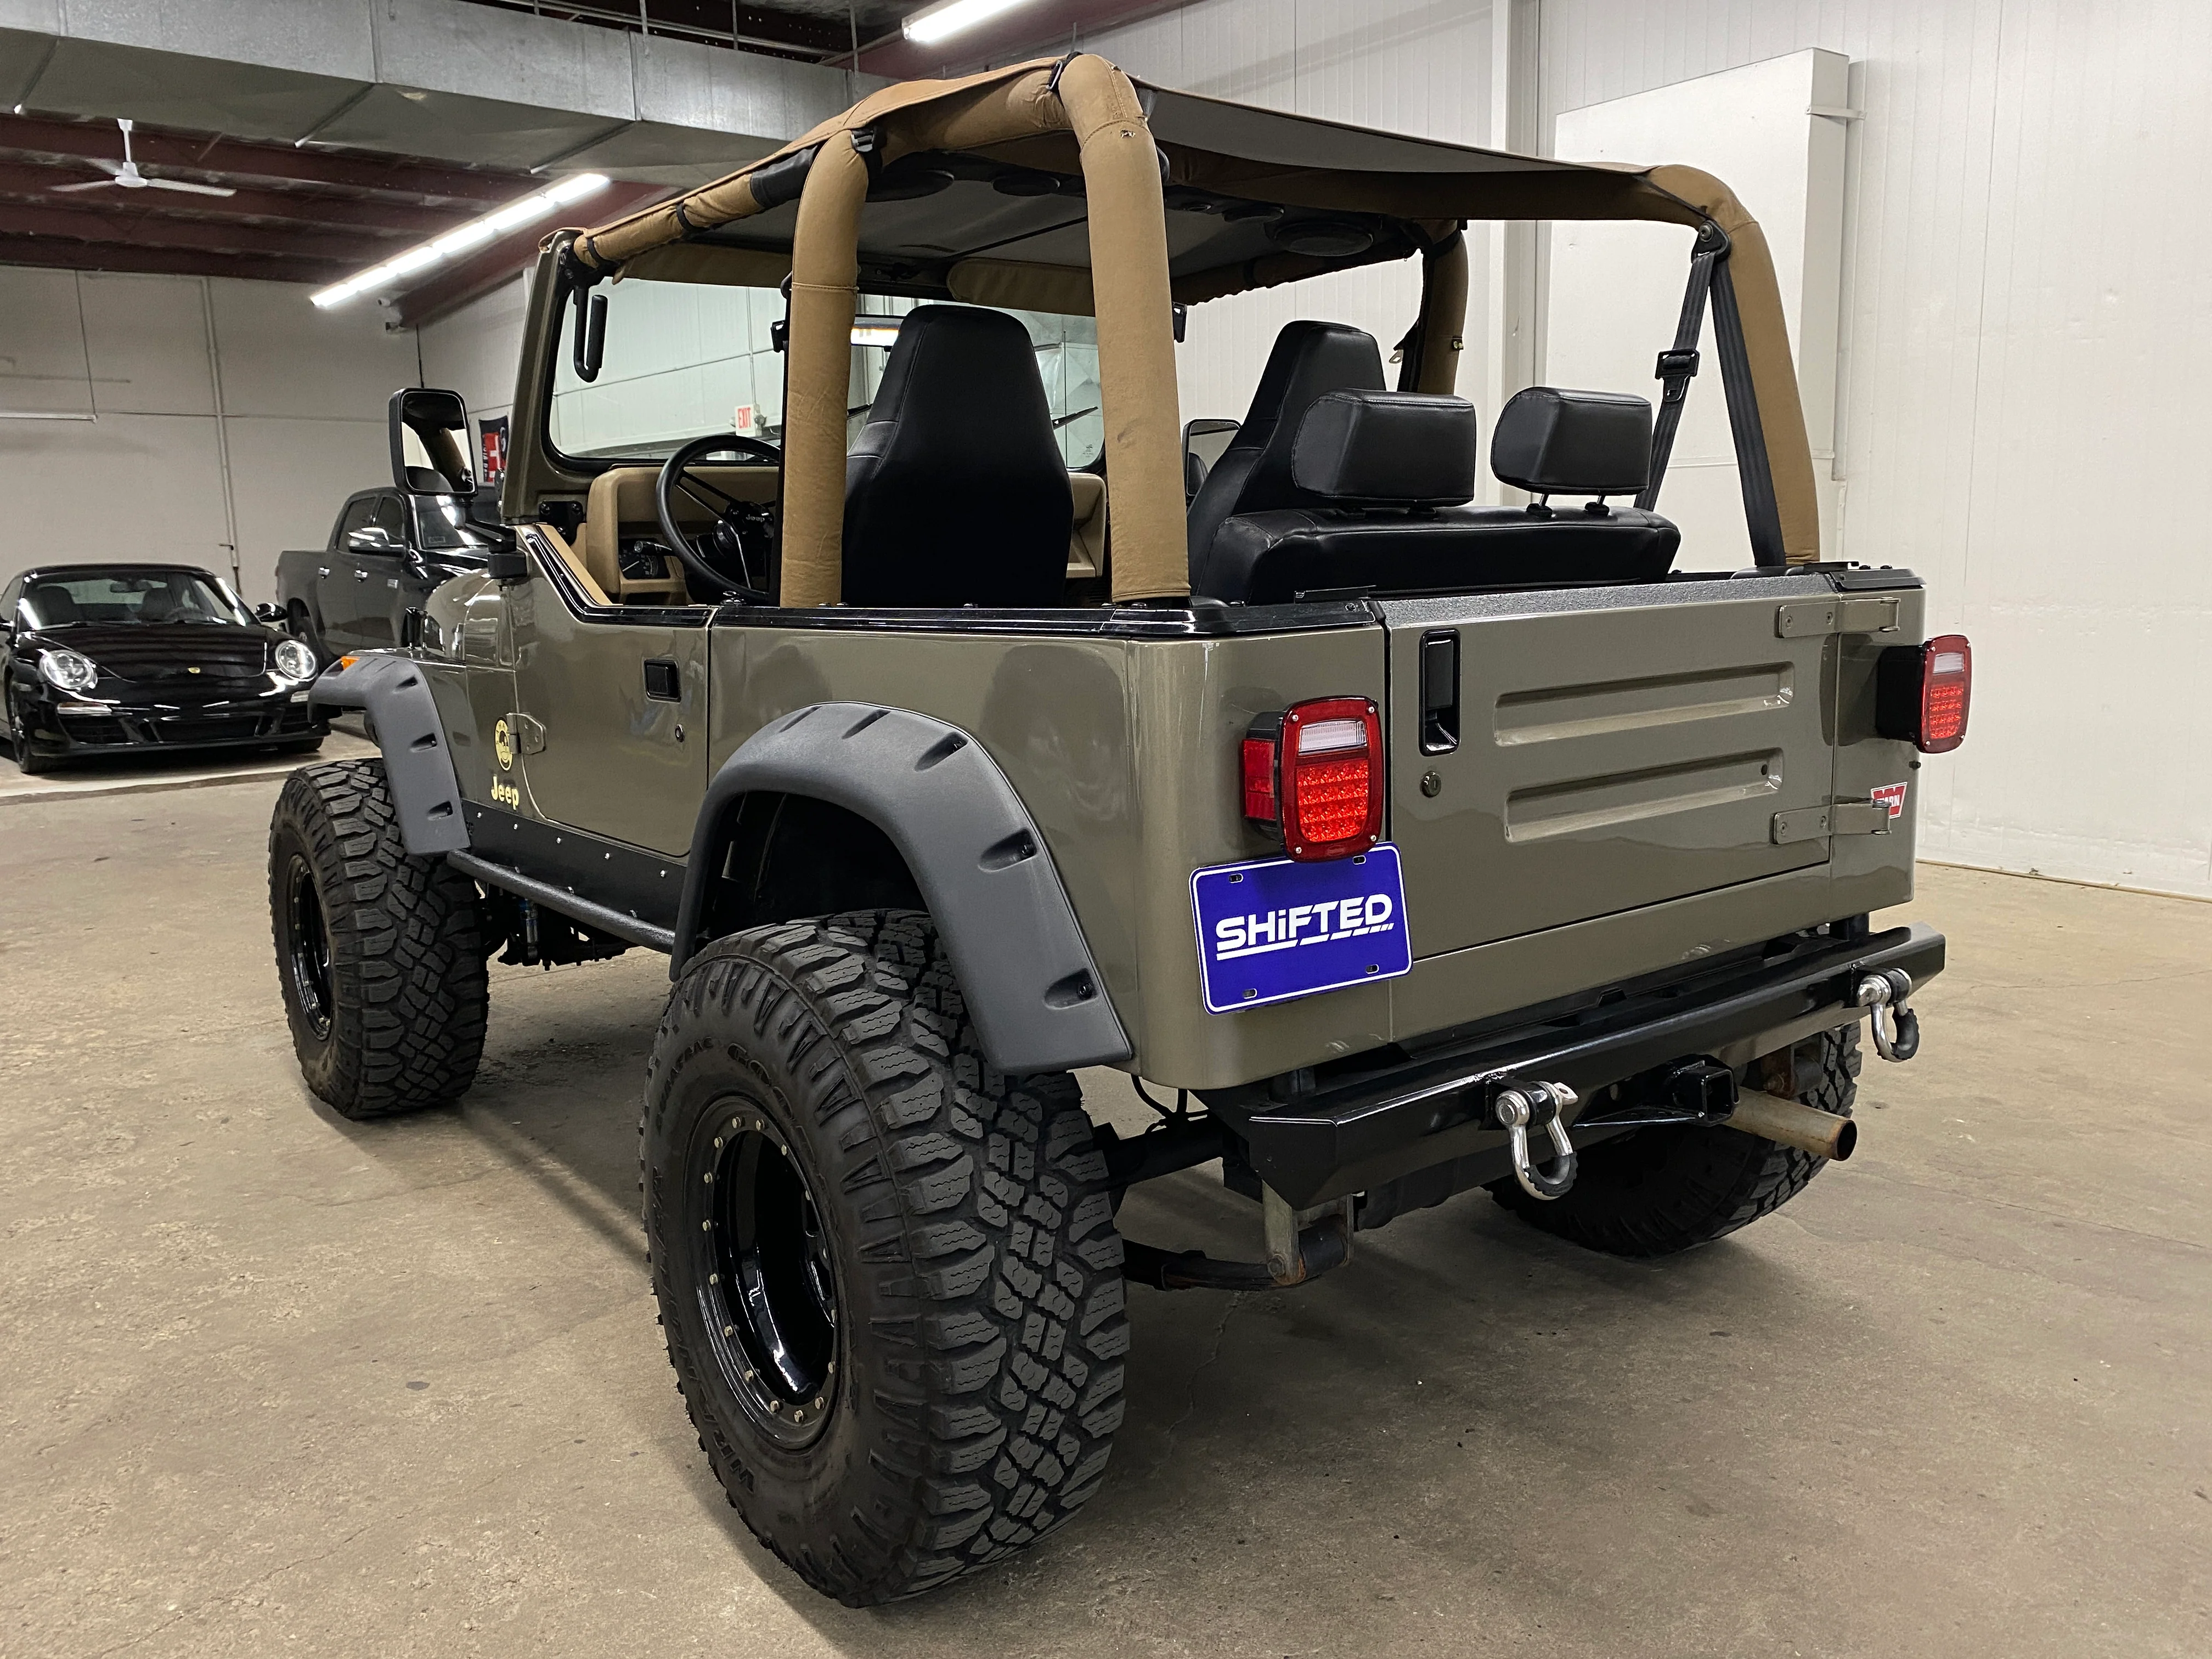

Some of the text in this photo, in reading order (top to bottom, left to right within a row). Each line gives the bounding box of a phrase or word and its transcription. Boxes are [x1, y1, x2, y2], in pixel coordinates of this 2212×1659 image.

[737, 407, 751, 428] EXIT
[746, 514, 765, 522] Jeep
[491, 775, 519, 810] Jeep
